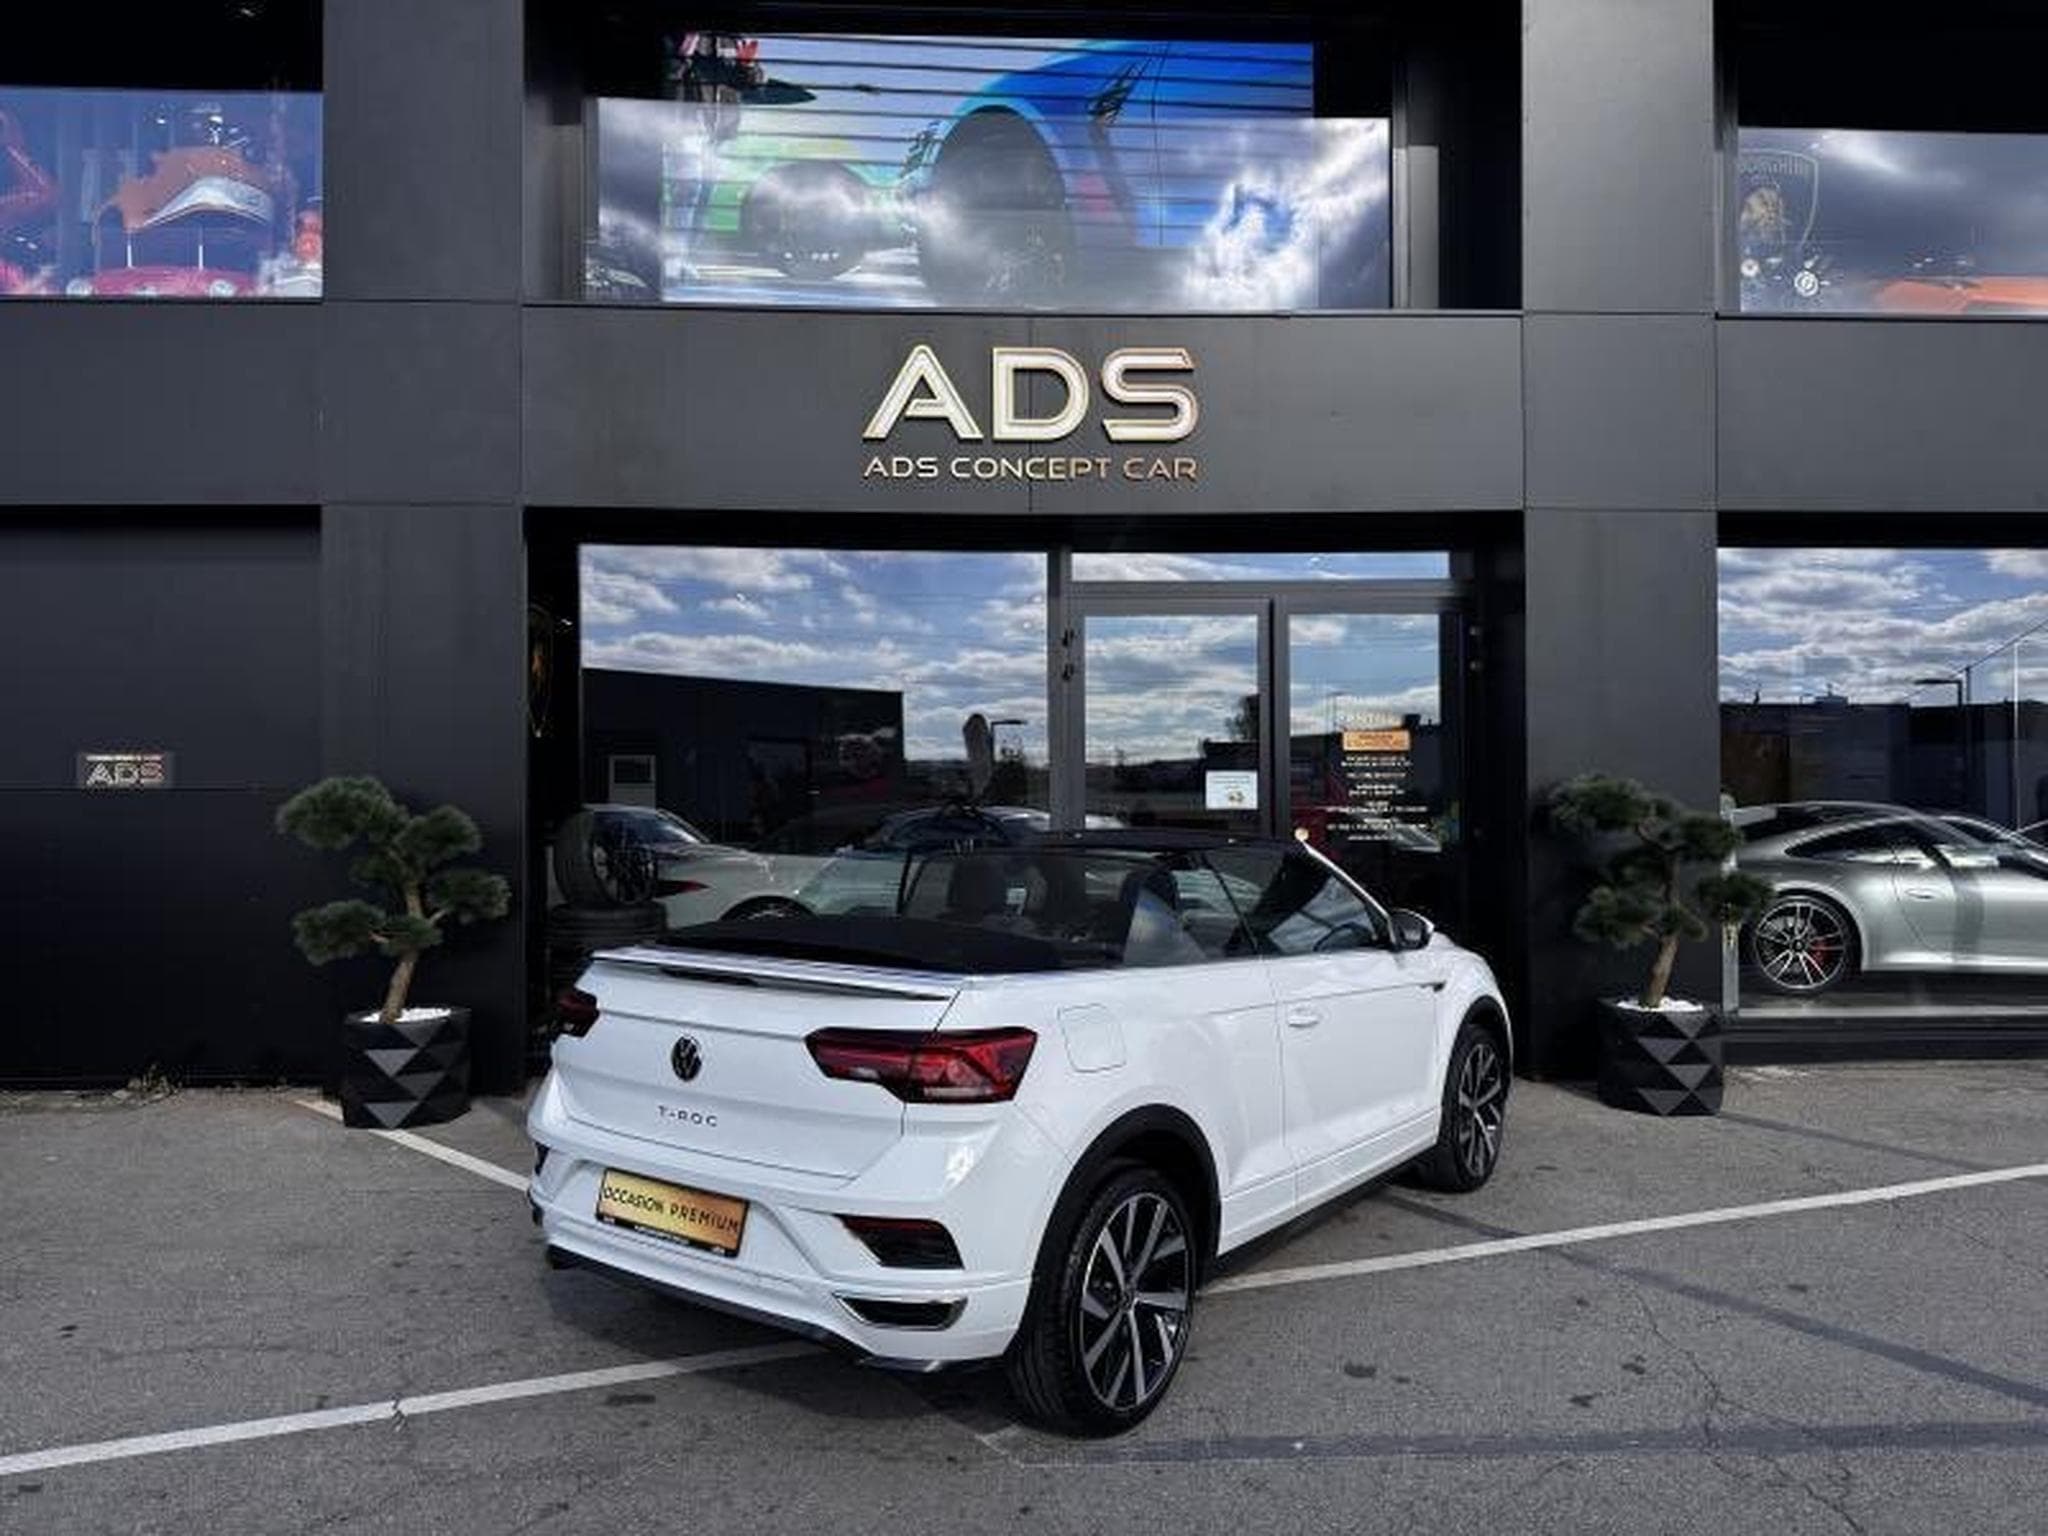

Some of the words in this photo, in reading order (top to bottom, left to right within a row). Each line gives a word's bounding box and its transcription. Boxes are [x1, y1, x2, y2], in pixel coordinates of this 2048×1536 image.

[862, 343, 1198, 442] ADS
[863, 457, 939, 479] ADS
[951, 457, 1111, 481] CONCEPT
[1122, 458, 1198, 482] CAR
[658, 1105, 718, 1128] T-ROC
[603, 1186, 665, 1214] OCCASION
[670, 1203, 739, 1234] PREMIUM
